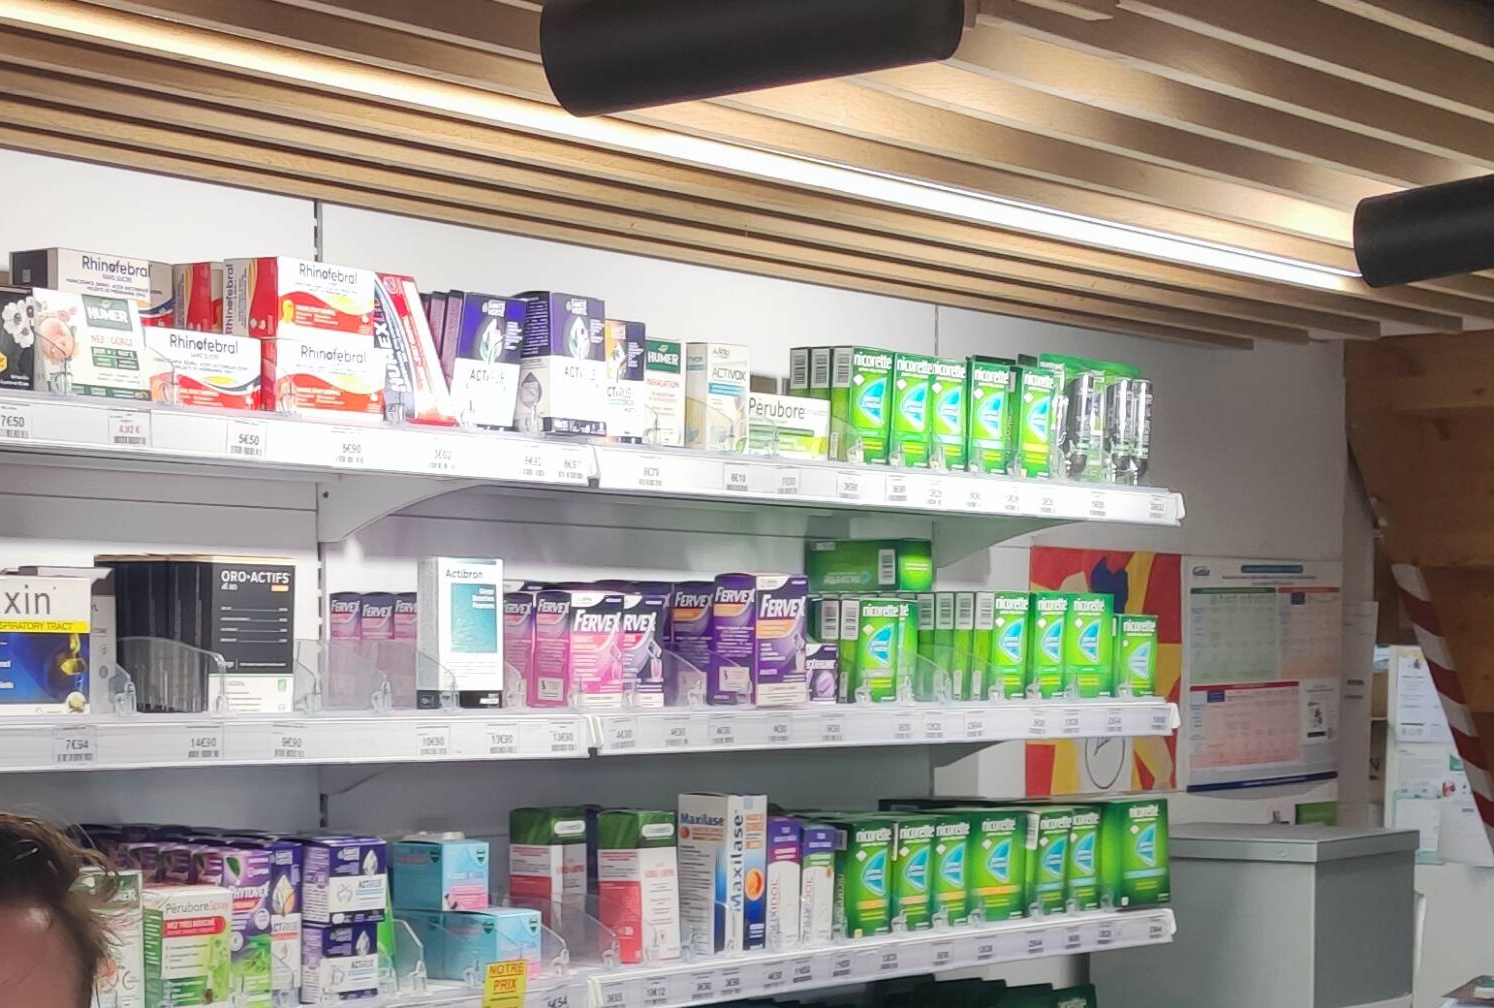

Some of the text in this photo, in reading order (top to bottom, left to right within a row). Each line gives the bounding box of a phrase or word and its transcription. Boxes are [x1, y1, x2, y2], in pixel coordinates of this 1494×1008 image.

[81, 255, 152, 279] Rhinofebral
[298, 262, 359, 286] Rhinofebral
[86, 303, 129, 324] HUMER
[169, 332, 240, 356] Rhinofebral
[300, 343, 368, 365] Rhinofebral
[647, 350, 680, 365] HUMER
[854, 353, 893, 370] nicorette
[896, 356, 932, 373] nicorette
[932, 361, 967, 377] nicorette
[974, 366, 1009, 384] nicorette
[748, 396, 806, 420] Pérubore
[0, 413, 26, 429] 7€50
[238, 434, 260, 447] 5€50
[445, 568, 484, 580] Actibron
[674, 591, 712, 608] FERVEX
[714, 586, 755, 605] FERVEX
[996, 594, 1029, 612] nicorette
[331, 600, 360, 615] FERVEX
[362, 603, 393, 619] FERVEX
[538, 599, 570, 615] FERVEX
[759, 593, 806, 619] FERVEX
[861, 604, 900, 618] nicorette
[1037, 597, 1067, 612] nicorette
[1073, 597, 1105, 612] nicorette
[45, 621, 73, 632] TRACT
[573, 609, 622, 633] FERVEX
[1122, 620, 1157, 633] nicorette
[1128, 804, 1158, 819] nicorette
[680, 813, 725, 827] Maxilase
[982, 818, 1016, 833] nicorette
[1040, 815, 1072, 830] nicorette
[856, 828, 891, 843] nicorette
[900, 824, 935, 840] nicorette
[936, 821, 970, 837] nicorette
[730, 813, 744, 913] Maxilase
[489, 963, 524, 976] NOTRE
[493, 979, 518, 993] PRIX
